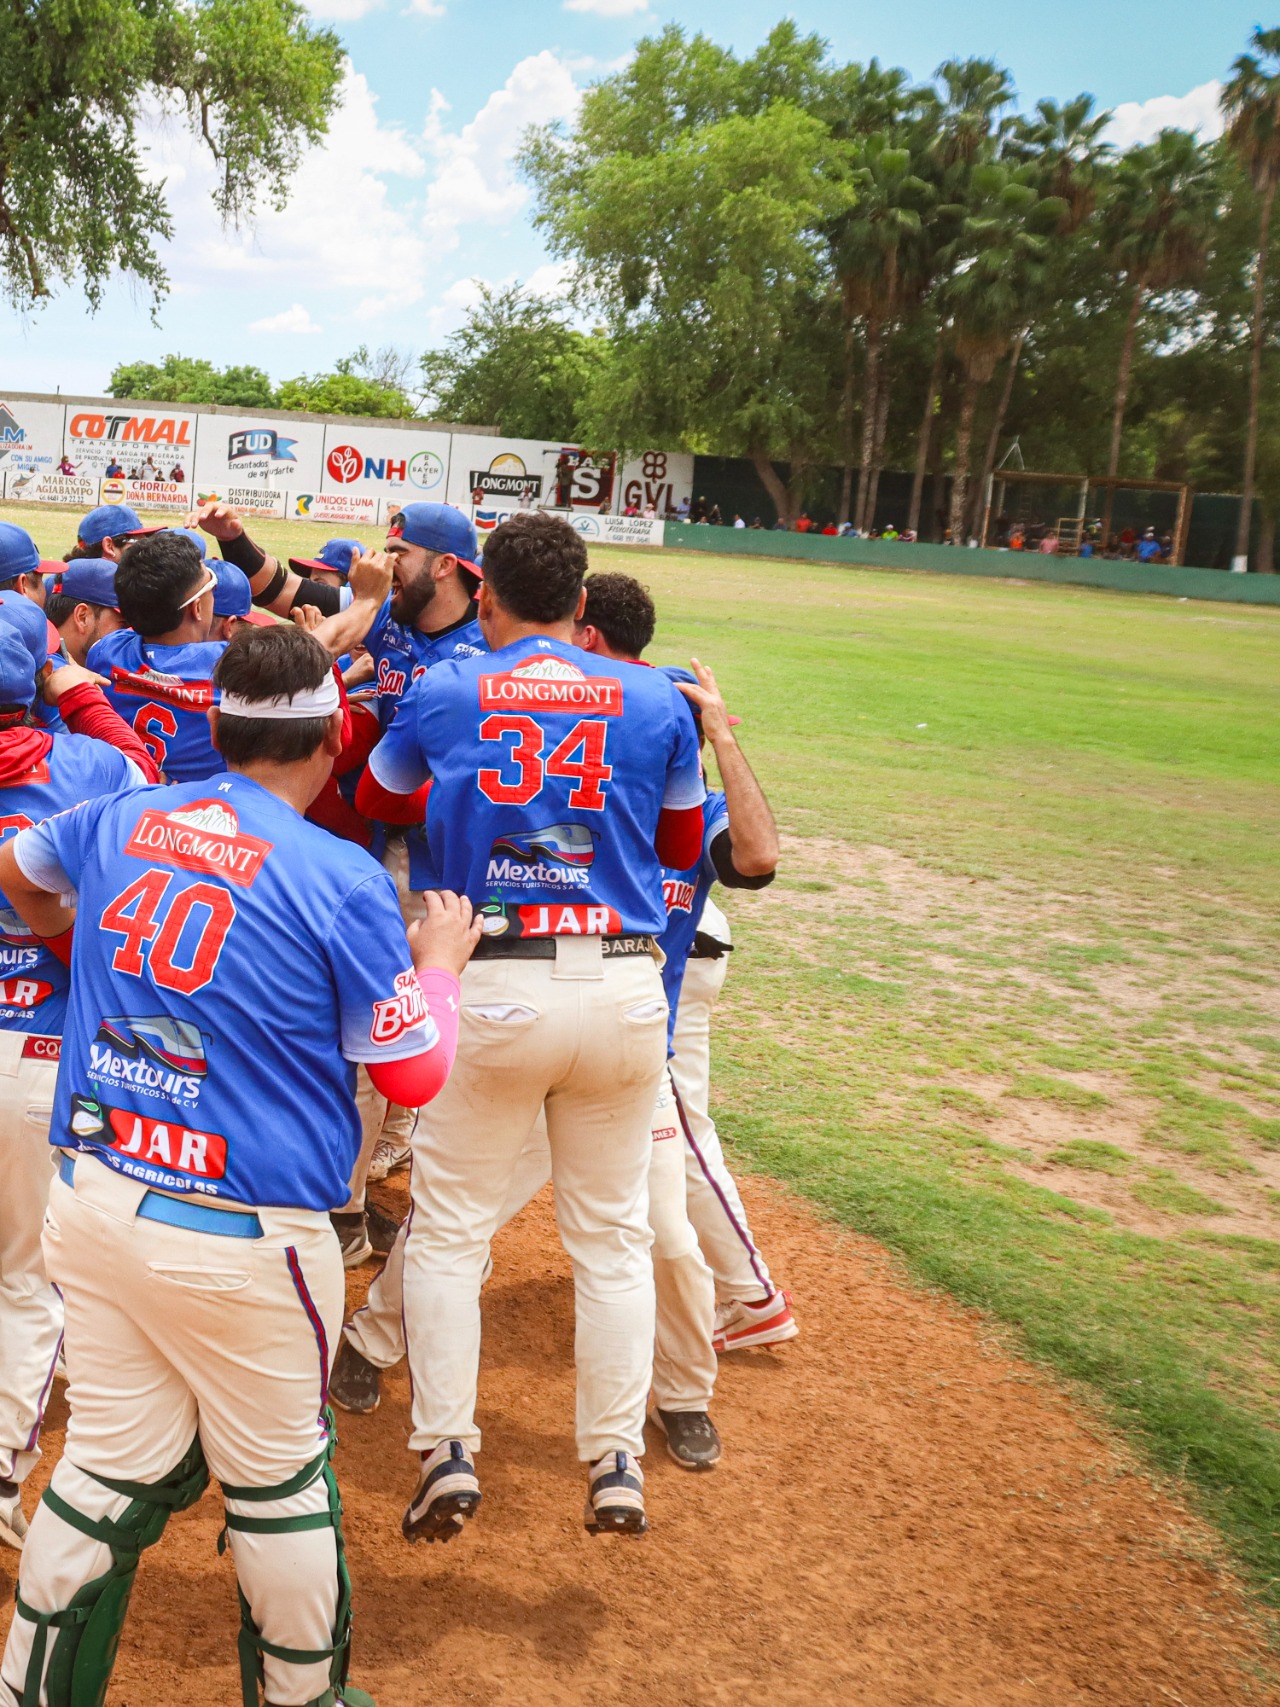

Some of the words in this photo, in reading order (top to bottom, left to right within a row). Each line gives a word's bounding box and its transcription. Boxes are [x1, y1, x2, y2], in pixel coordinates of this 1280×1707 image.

[70, 413, 191, 445] COTMAL
[70, 439, 180, 452] TRANSPORTES
[230, 434, 273, 456] FUD
[11, 454, 23, 462] CON
[34, 456, 53, 464] AMIGO
[229, 460, 269, 470] Encantados
[248, 471, 257, 479] de
[260, 466, 295, 479] ayudarte
[364, 458, 406, 481] NH
[413, 466, 438, 475] BAYER
[42, 475, 92, 487] MARISCOS
[132, 481, 178, 493] CHORIZO
[473, 473, 539, 493] LONGMONT
[36, 484, 94, 496] AGIABAMPO
[228, 488, 281, 499] DISTRIBUIDORA
[147, 492, 189, 504] BERNARDA
[228, 498, 274, 508] BOJORQUEZ
[315, 495, 348, 506] UNIDOS
[350, 497, 374, 508] LUNA
[605, 517, 623, 525] LUISA
[377, 658, 406, 698] San
[485, 678, 616, 706] LONGMONT
[477, 713, 613, 812] 34
[134, 815, 259, 872] LONGMONT
[486, 859, 590, 884] Mextours
[521, 882, 562, 890] TURISTICOS
[530, 906, 610, 934] JAR
[99, 867, 238, 996] 40
[90, 1043, 202, 1099] Mextours
[171, 1096, 181, 1105] de
[120, 1117, 208, 1173] JAR
